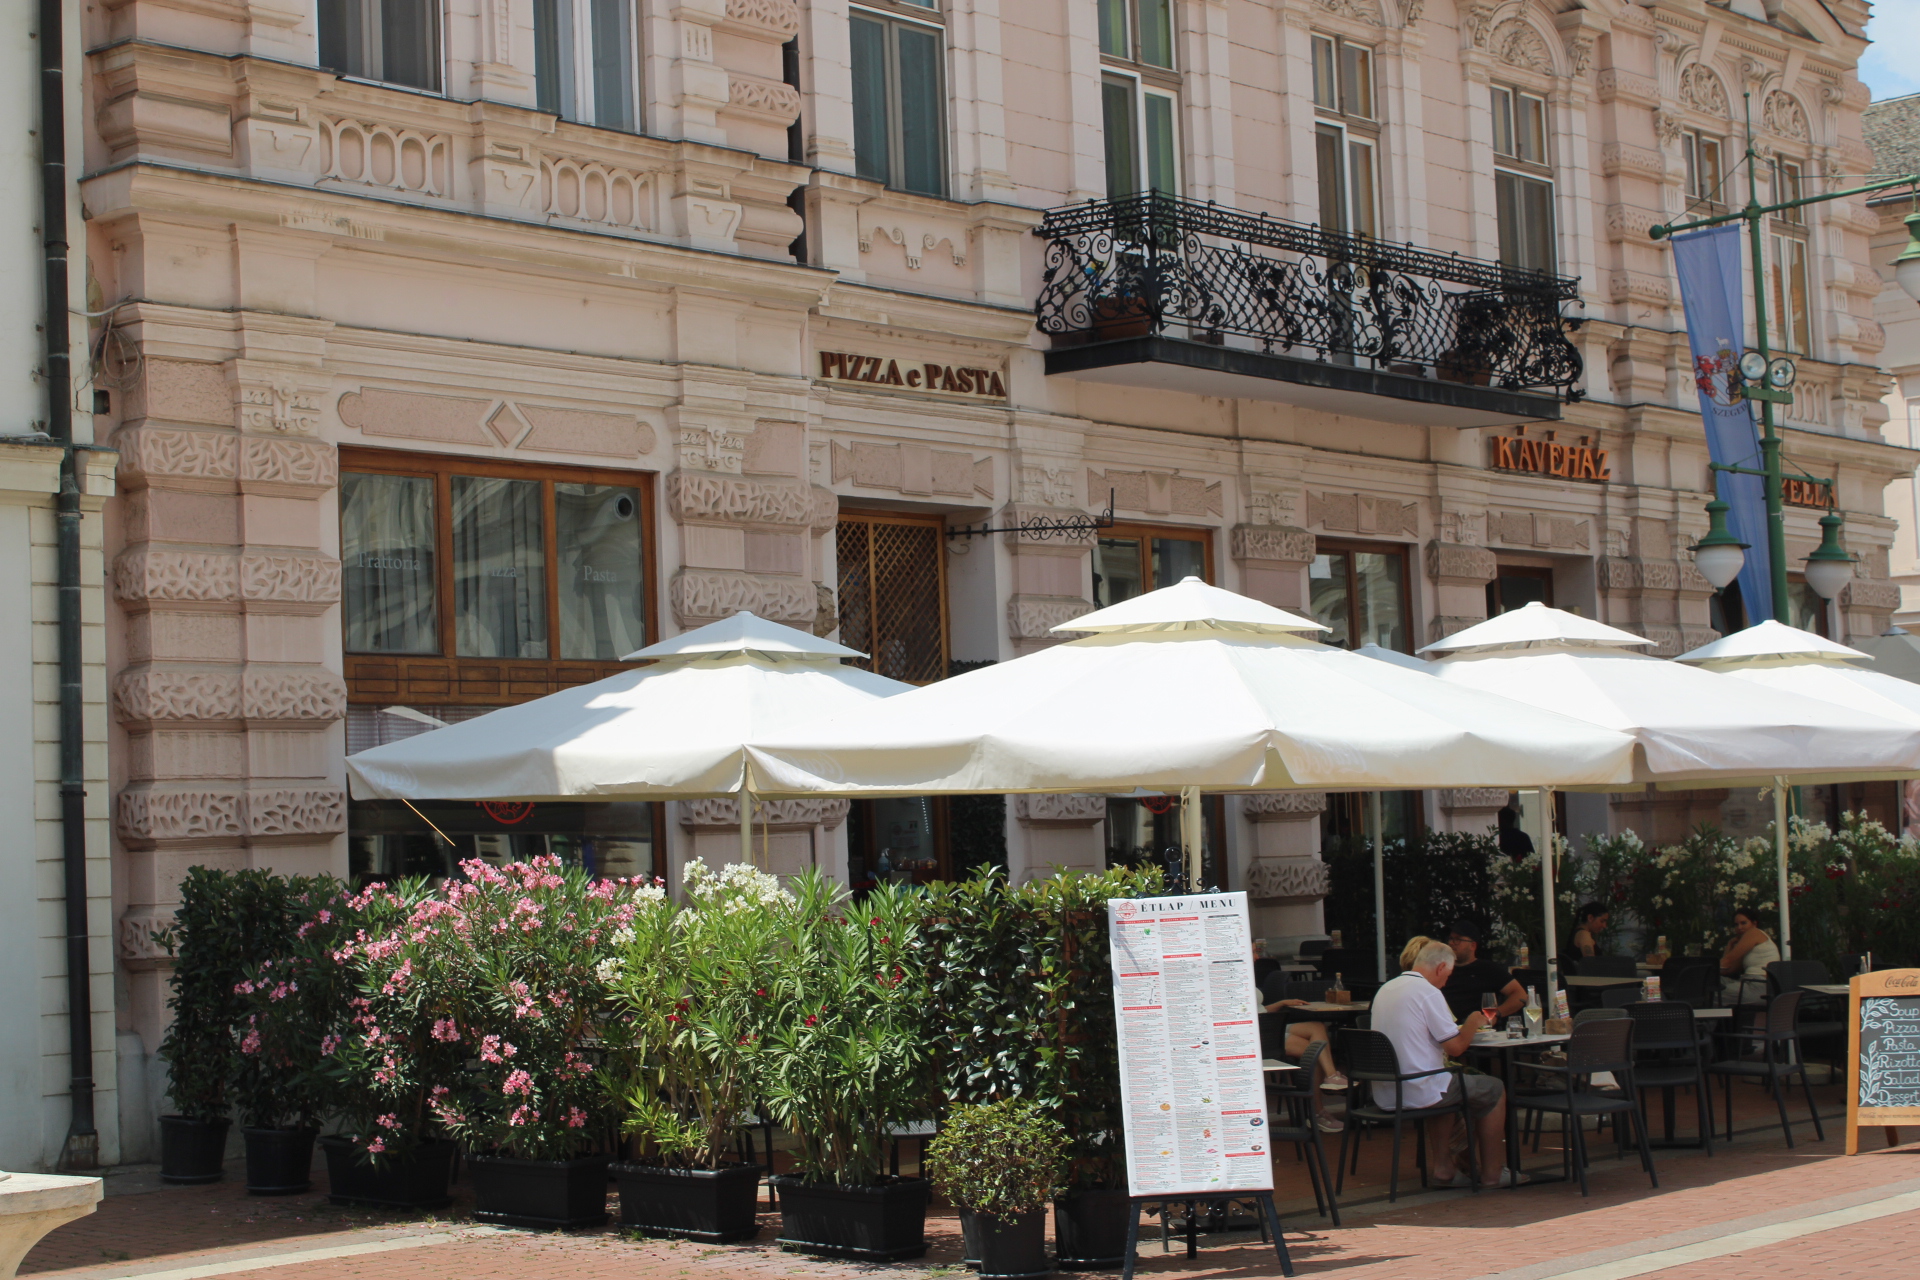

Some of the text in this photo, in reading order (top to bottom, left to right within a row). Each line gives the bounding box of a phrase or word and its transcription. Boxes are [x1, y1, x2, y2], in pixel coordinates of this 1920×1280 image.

[819, 351, 1007, 397] PIZZA e PASTA
[1711, 403, 1748, 418] SZEGED
[1491, 425, 1611, 480] KÁVÉHÁZ
[357, 552, 421, 571] Trattoria
[584, 565, 617, 582] Pasta
[1141, 901, 1184, 913] ÉTLAP
[1199, 899, 1236, 909] MENU
[1889, 1002, 1919, 1018] Soup
[1883, 1020, 1919, 1034] Pizza
[1883, 1037, 1916, 1051] Pasta
